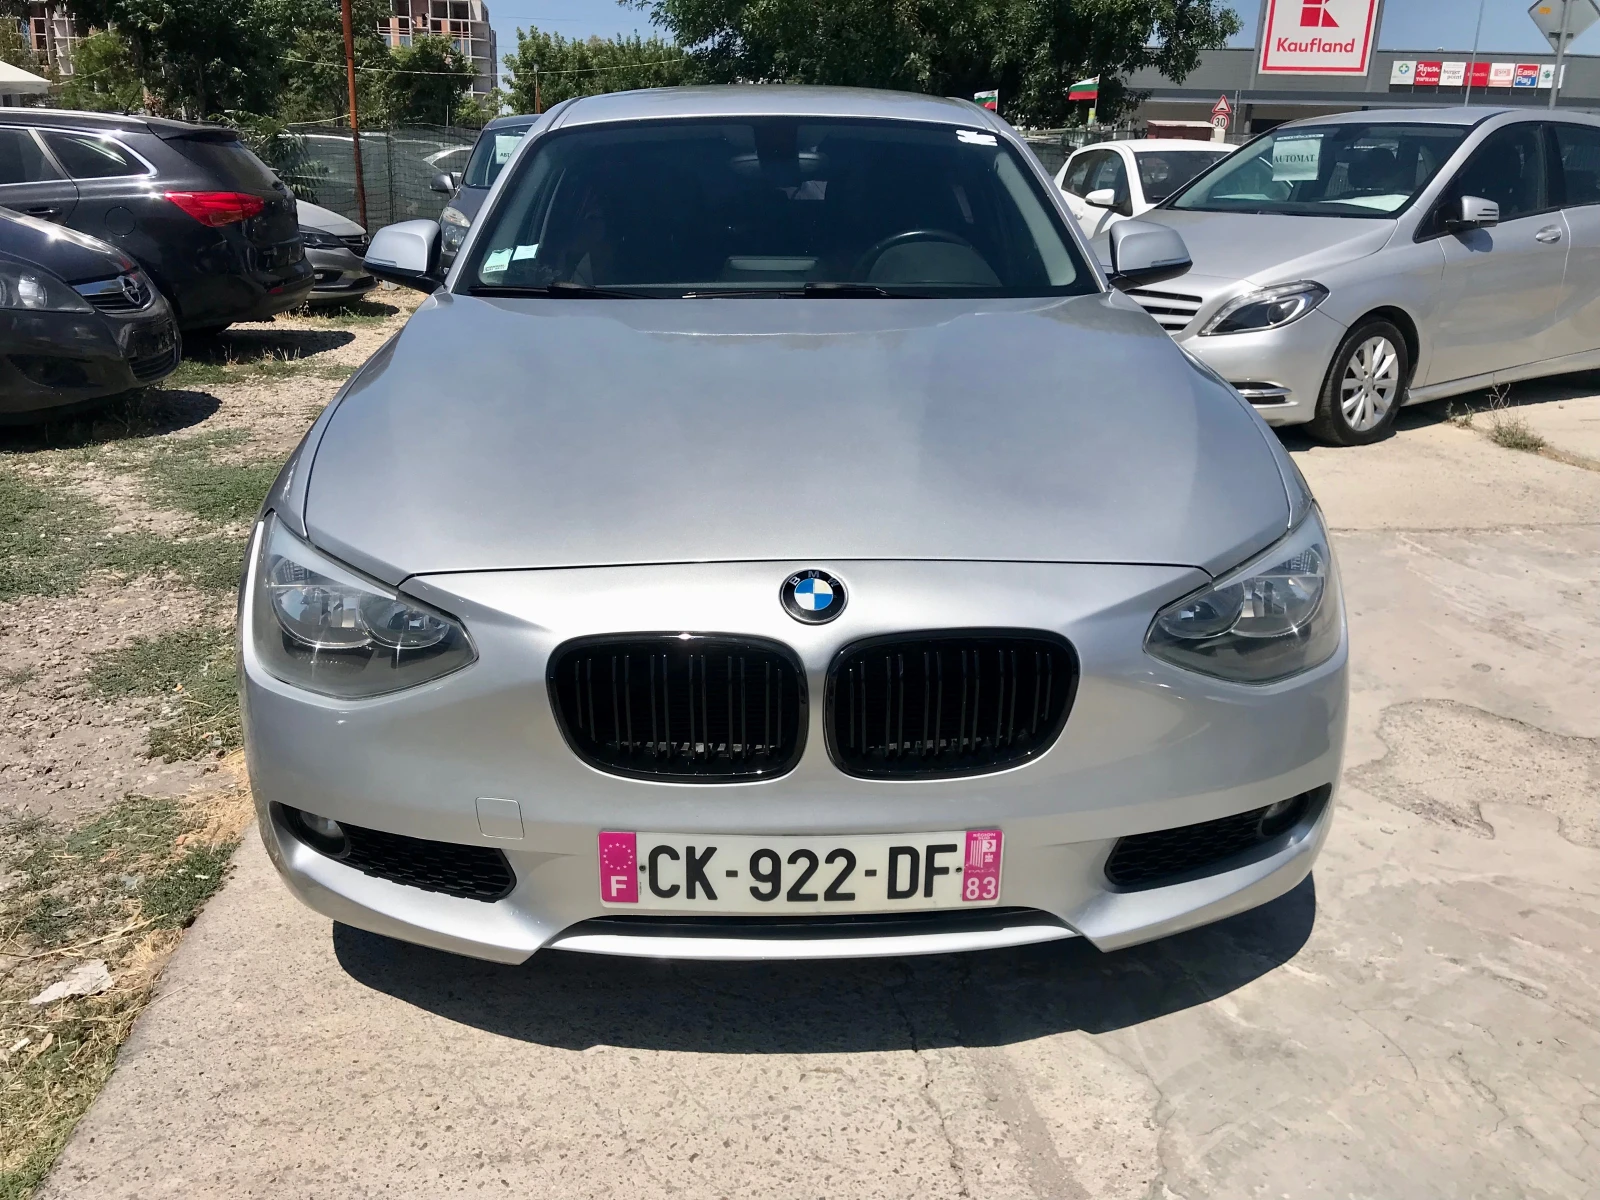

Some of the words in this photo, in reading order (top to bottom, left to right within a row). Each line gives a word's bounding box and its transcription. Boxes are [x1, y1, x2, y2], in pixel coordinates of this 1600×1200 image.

[1276, 37, 1356, 53] Kaufland
[1517, 67, 1537, 77] Easy
[1515, 76, 1532, 85] Pay
[1214, 117, 1226, 127] 30
[1273, 154, 1315, 163] AUTOMAT
[789, 571, 840, 588] BMW
[648, 843, 958, 903] CK-922-DF
[610, 875, 628, 897] F
[966, 876, 996, 900] 83
